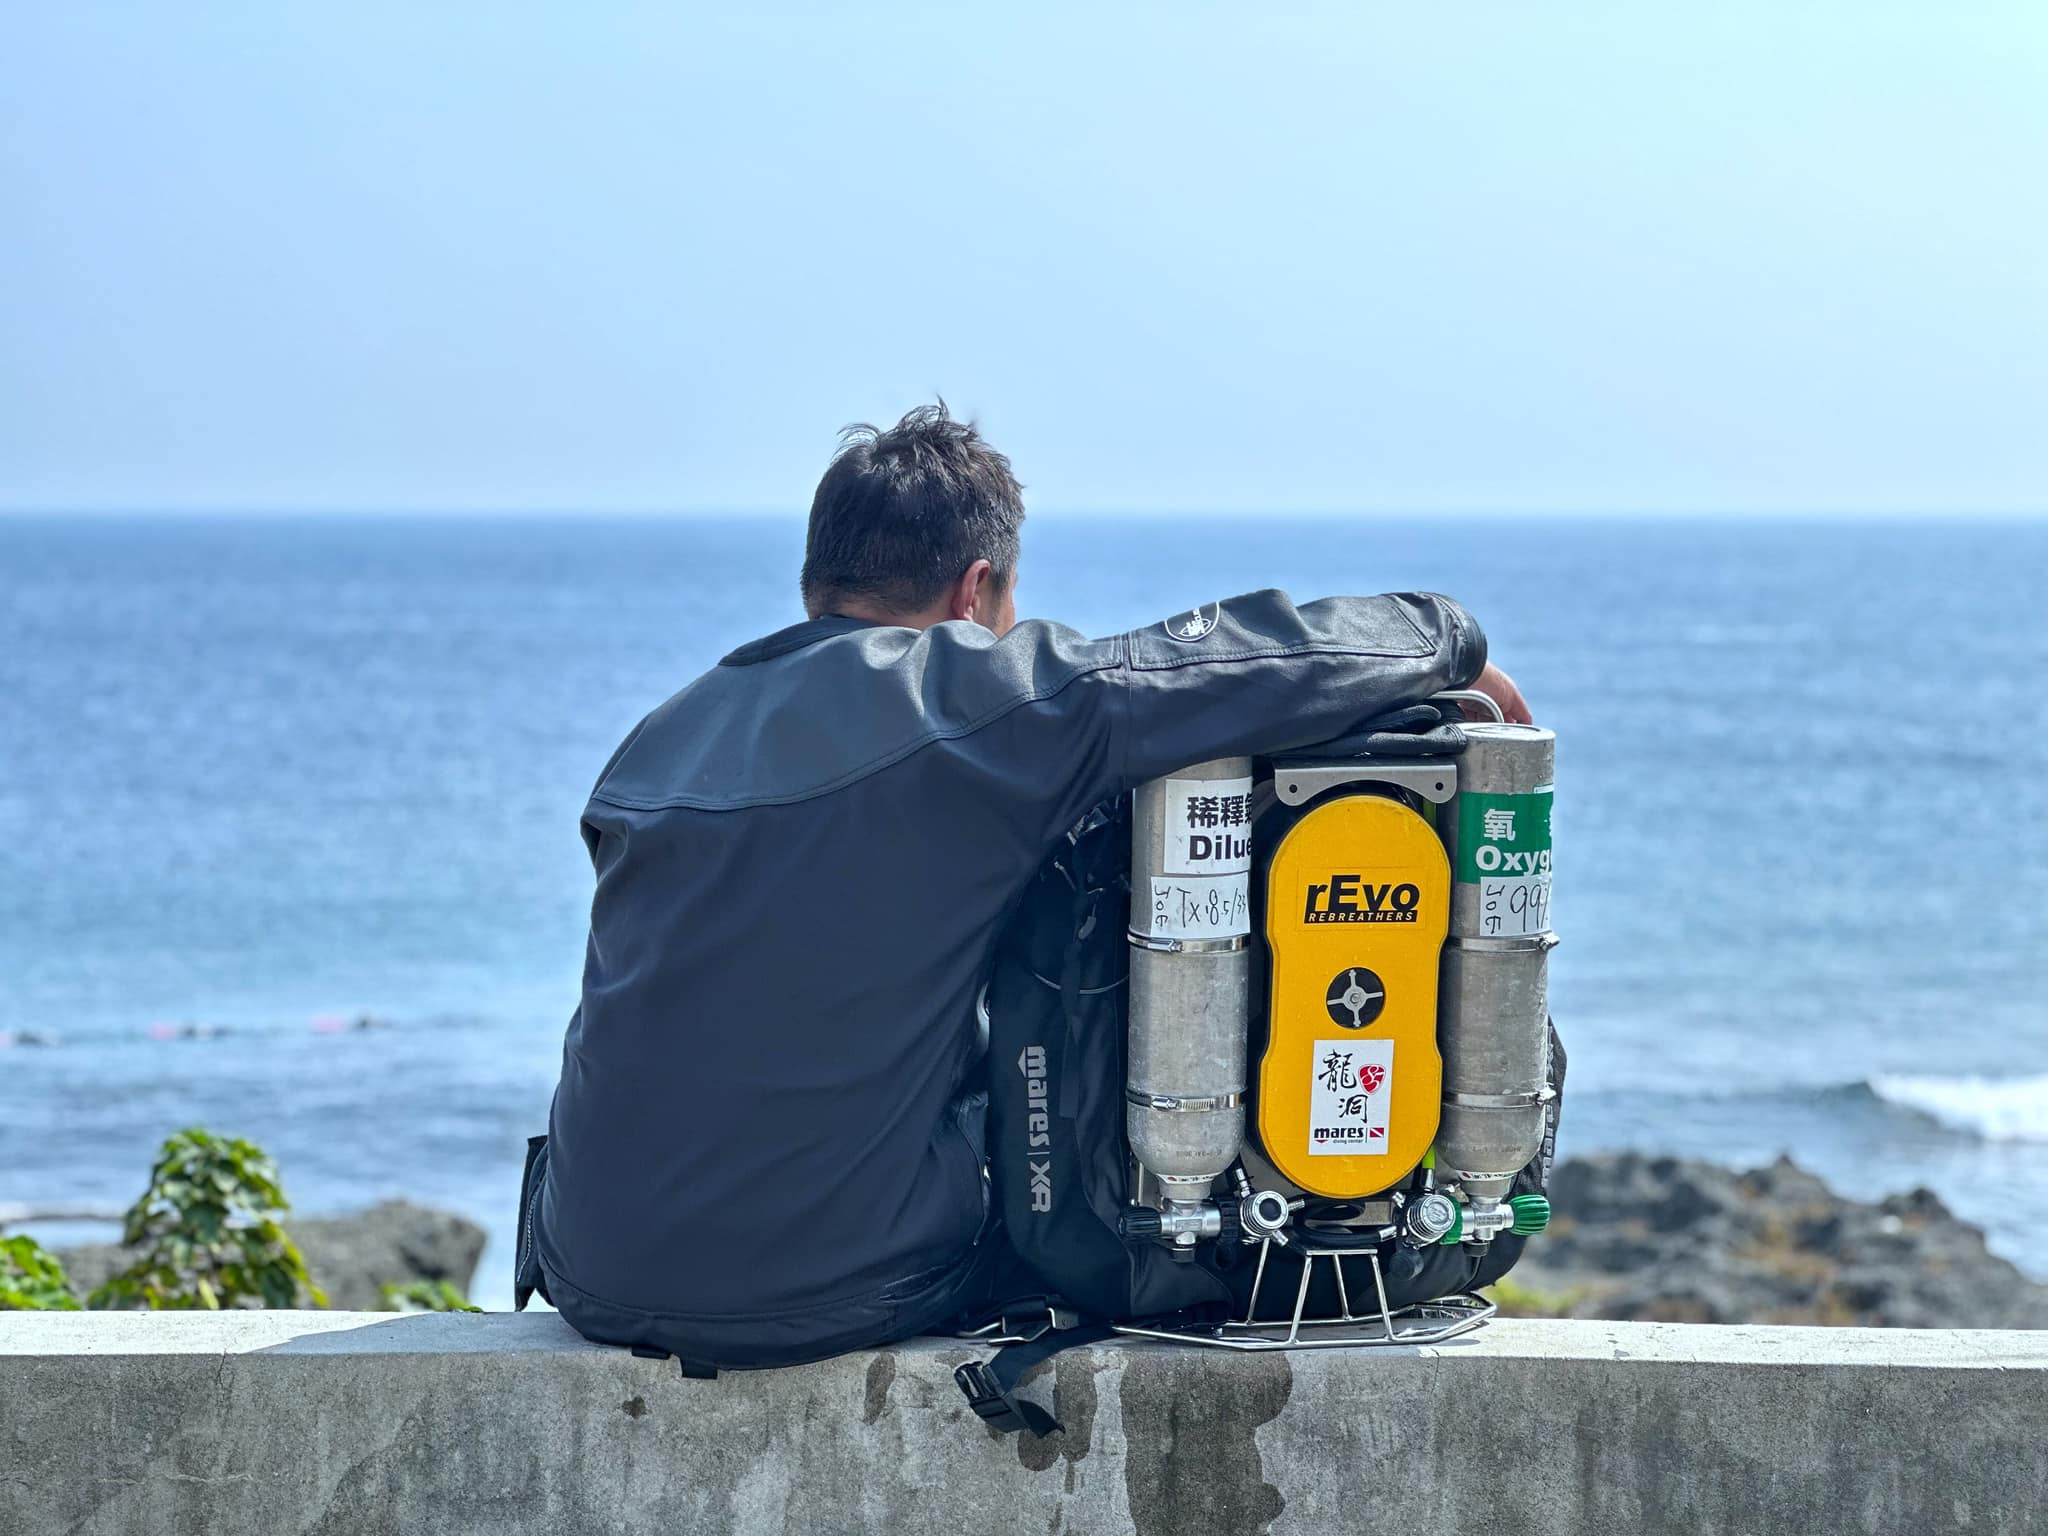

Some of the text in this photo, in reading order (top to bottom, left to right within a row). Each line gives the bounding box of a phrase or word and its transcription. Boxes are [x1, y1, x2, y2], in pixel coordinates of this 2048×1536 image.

[1304, 874, 1420, 912] rEvo
[1308, 911, 1414, 922] REBREATHERS
[1026, 1045, 1051, 1148] mares
[1314, 1127, 1364, 1138] mares
